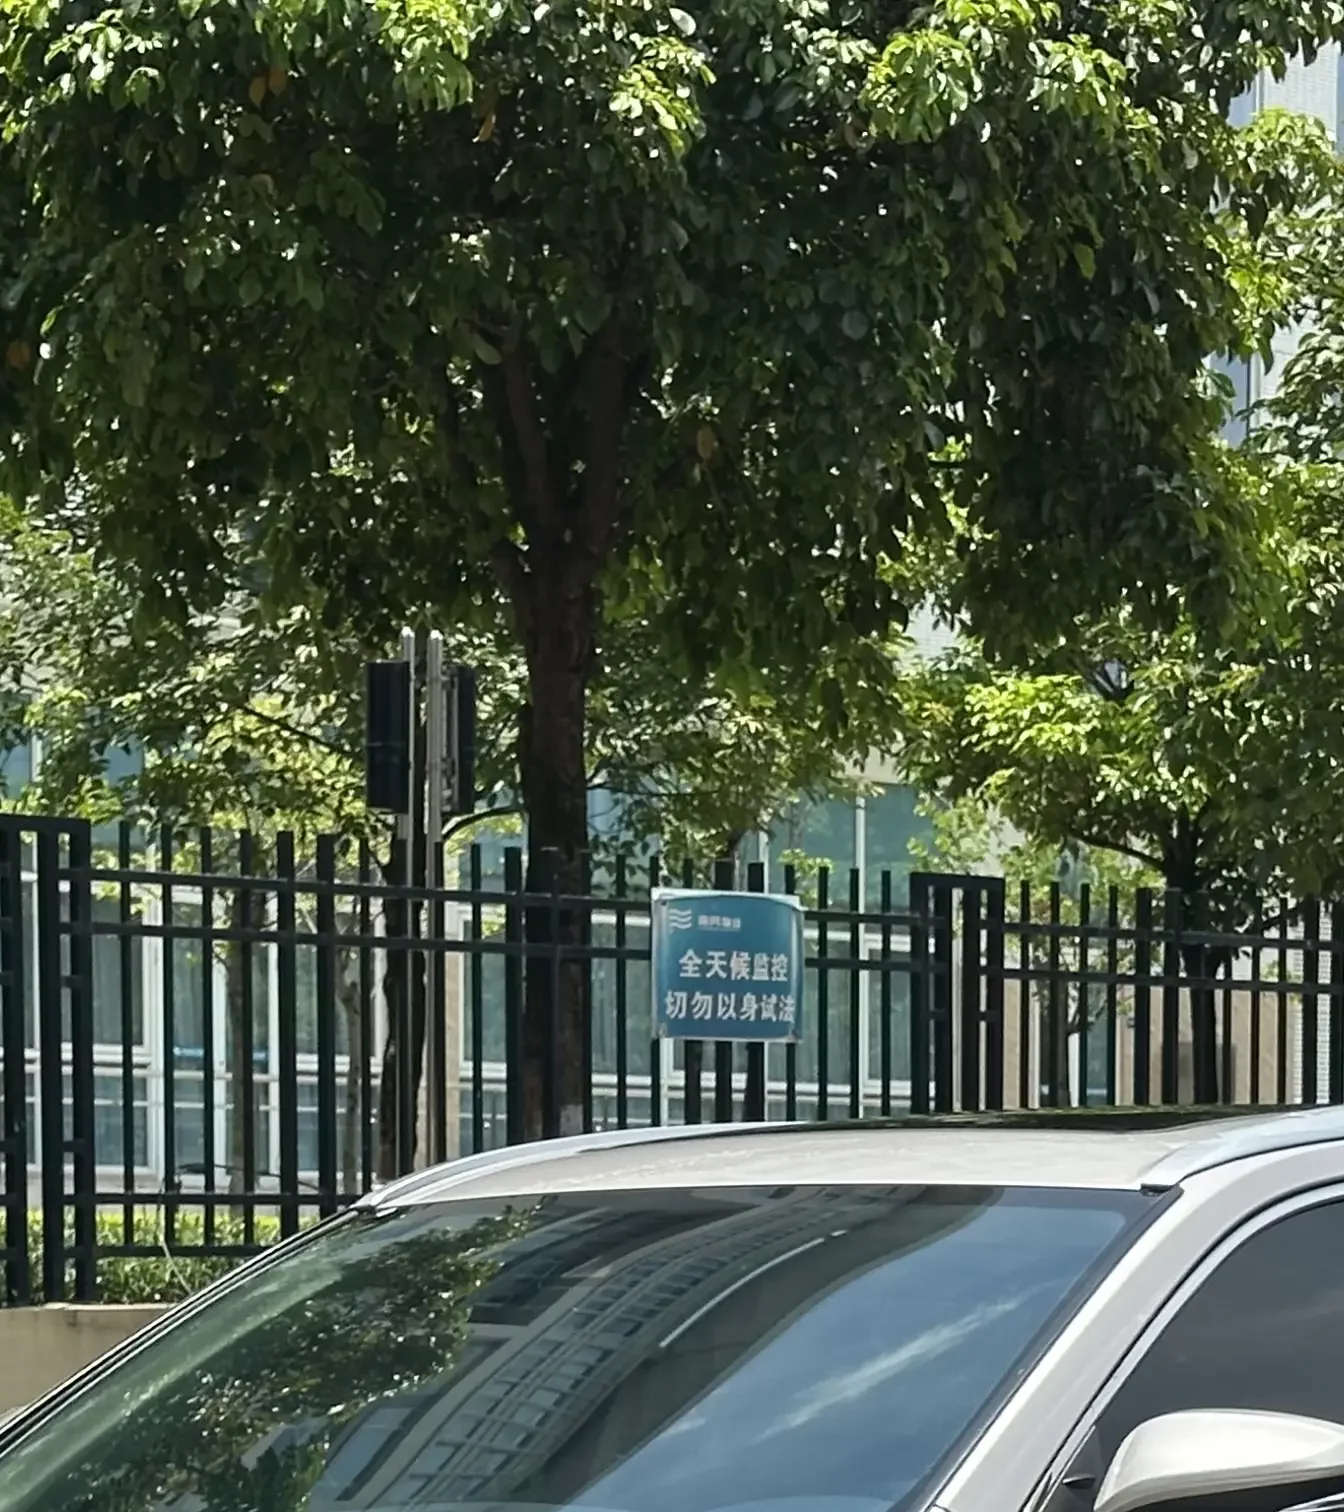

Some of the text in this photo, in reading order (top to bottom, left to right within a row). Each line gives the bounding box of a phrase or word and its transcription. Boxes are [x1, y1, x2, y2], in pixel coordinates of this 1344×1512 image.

[679, 948, 789, 982] 全天候监控
[665, 990, 796, 1023] 切勿以身试法
